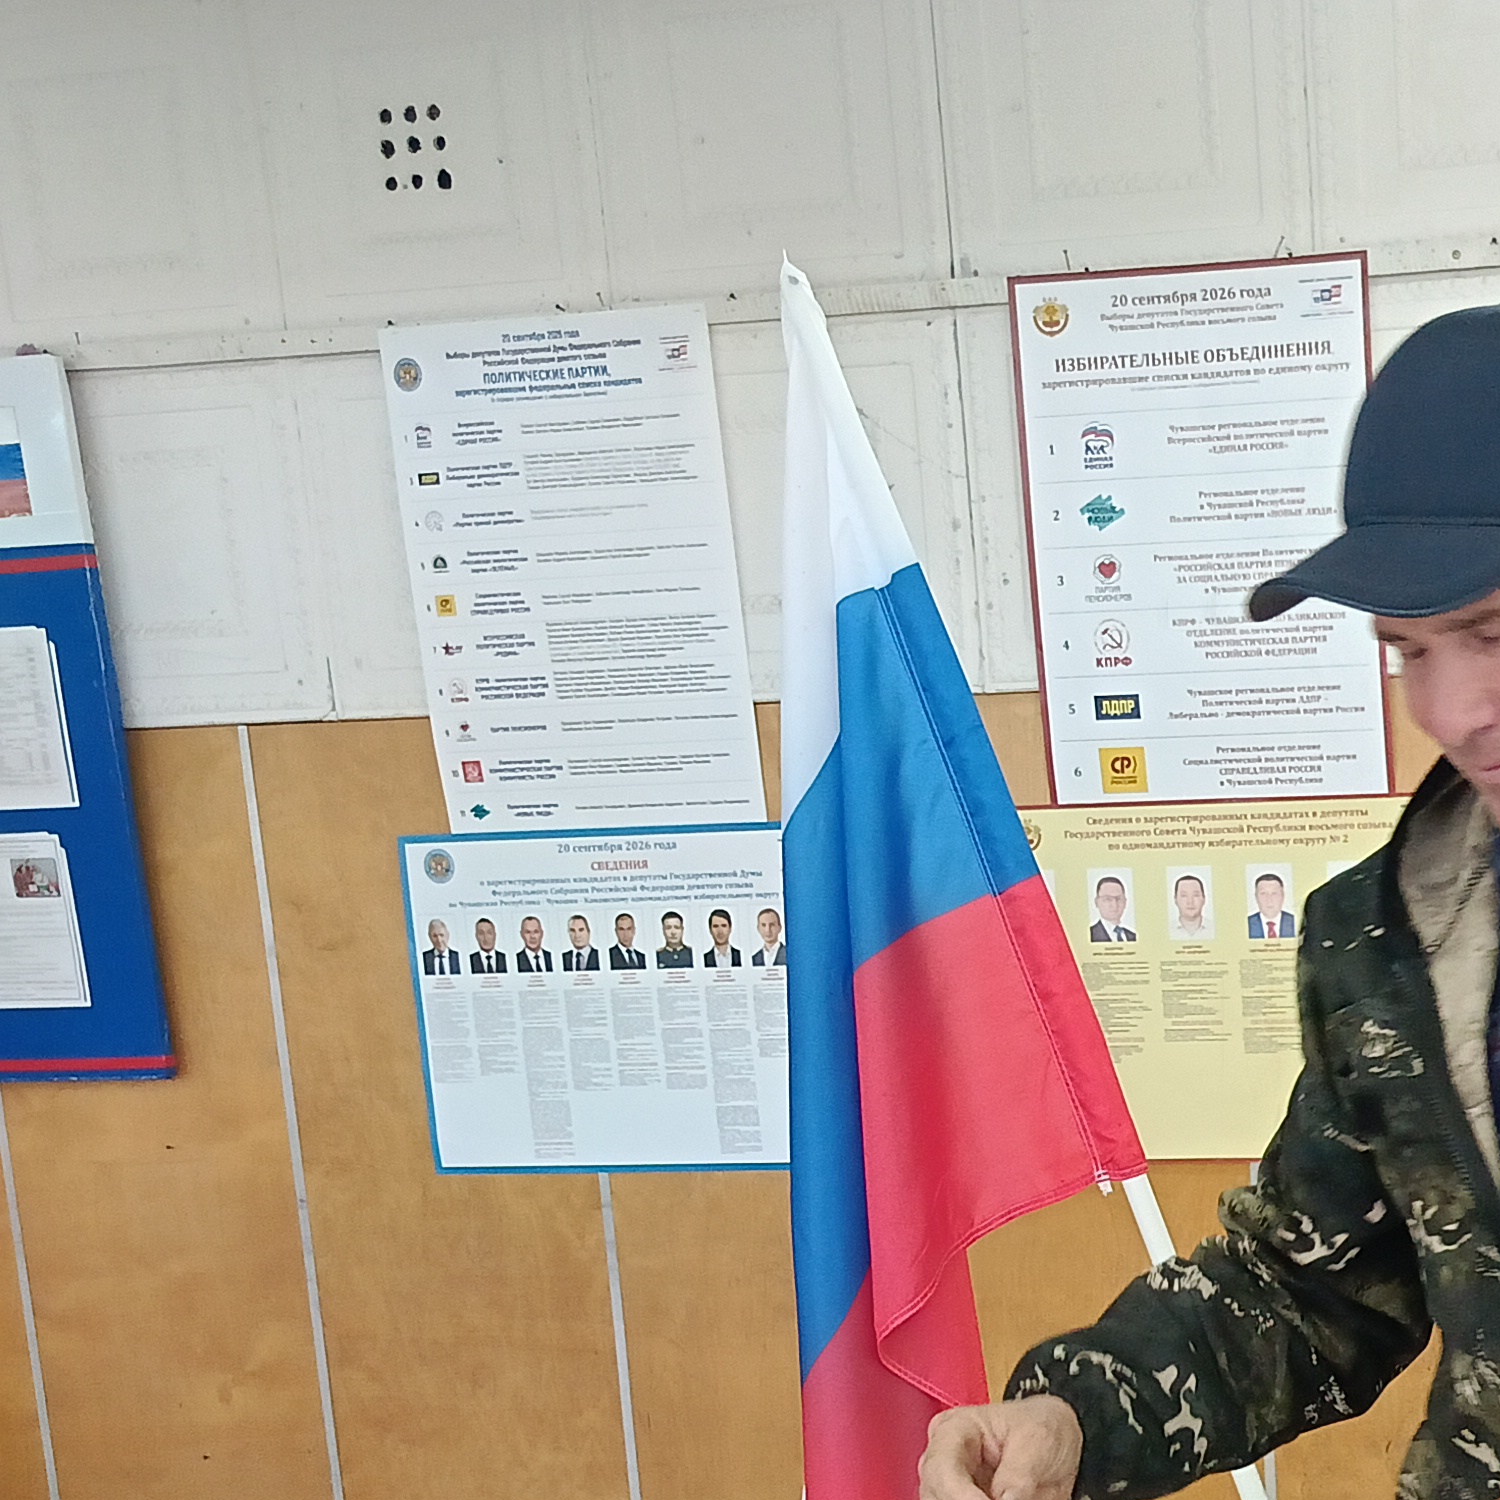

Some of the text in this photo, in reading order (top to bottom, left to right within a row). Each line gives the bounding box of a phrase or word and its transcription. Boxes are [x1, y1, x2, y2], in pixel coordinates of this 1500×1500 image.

[1111, 286, 1271, 308] 20 сентября 2026 года
[1055, 340, 1332, 373] ИЗБИРАТЕЛЬНЫЕ ОБЪЕДИНЕНИЯ
[483, 368, 566, 384] ПОЛИТИЧЕСКИЕ
[1049, 444, 1054, 455] 1
[1053, 510, 1060, 521] 2
[1057, 575, 1064, 586] 3
[1063, 640, 1070, 650] 4
[1096, 656, 1132, 668] КПРФ
[1068, 704, 1076, 714] 5
[1101, 700, 1135, 716] ЛДПР
[1074, 766, 1082, 778] 6
[1086, 816, 1133, 826] Сведения
[1144, 812, 1248, 826] зарегистрированных
[1250, 810, 1310, 820] кандидатах
[1320, 809, 1368, 819] депутаты
[1064, 829, 1152, 841] Государственного
[1153, 827, 1187, 836] Совета
[1188, 824, 1244, 836] Чувашской
[1246, 822, 1306, 835] Республики
[558, 840, 678, 854] 20 сентября 2026 года
[590, 860, 648, 871] СВЕДЕНИЯ
